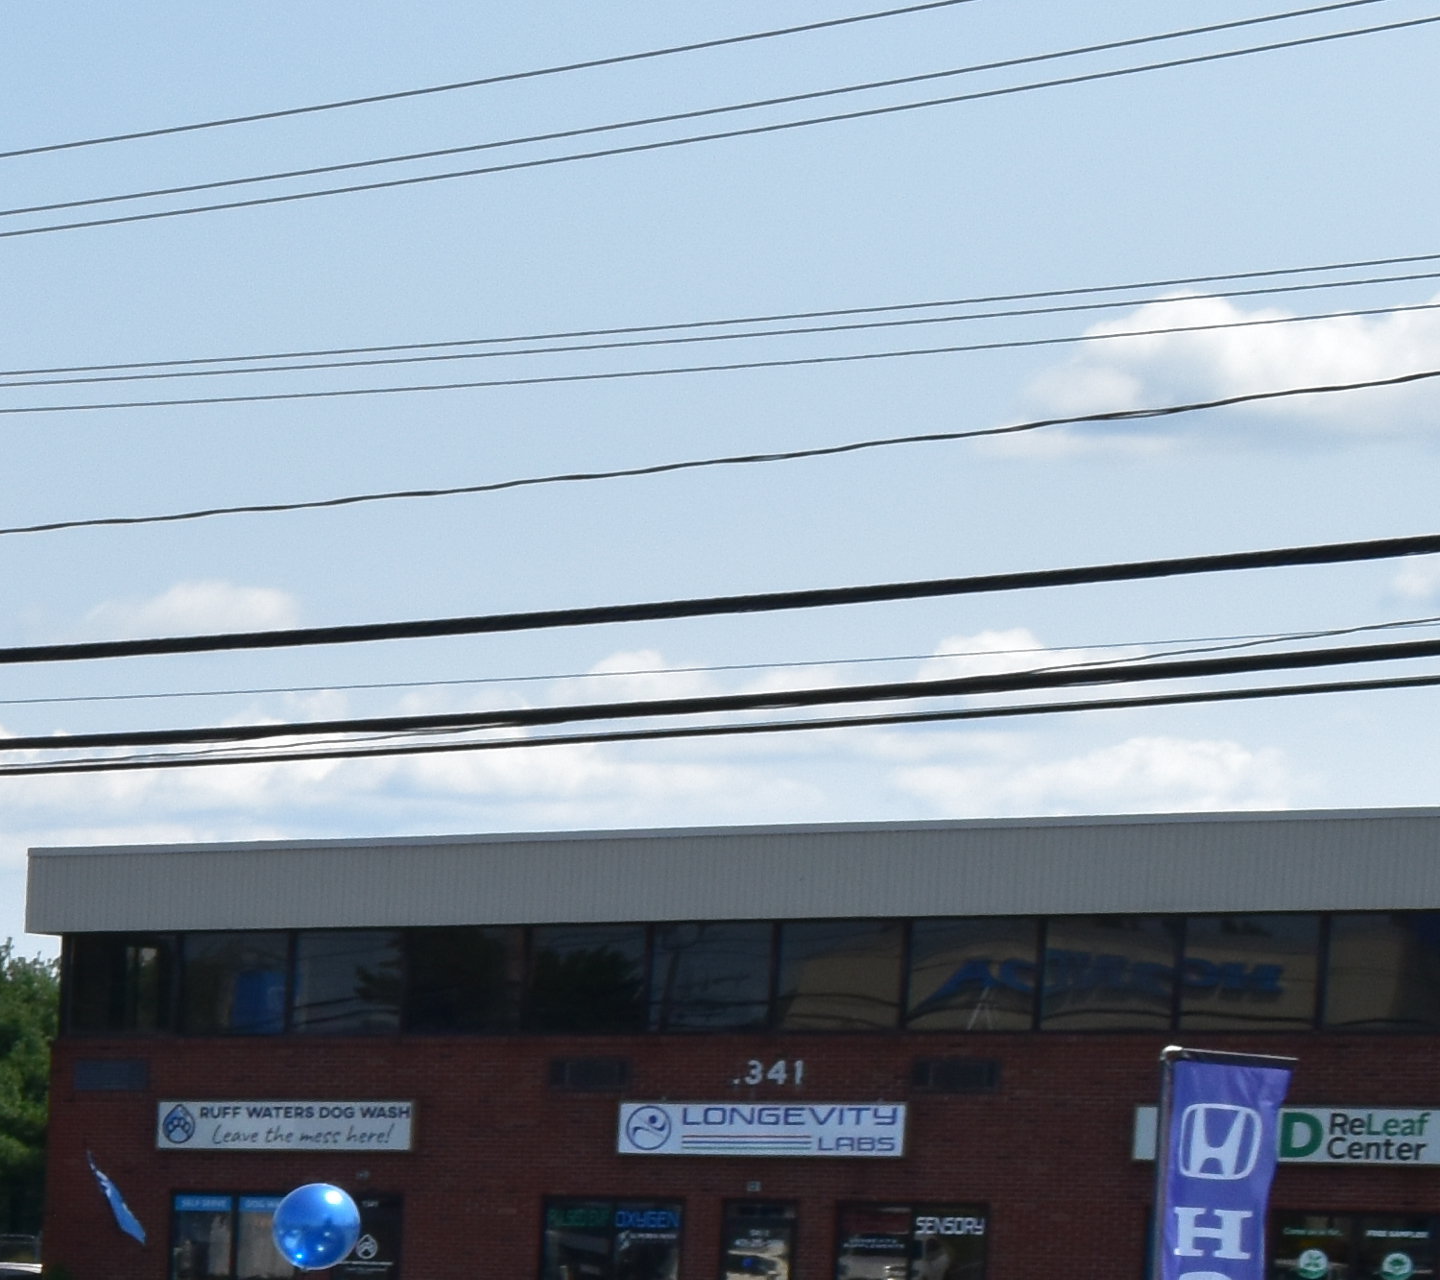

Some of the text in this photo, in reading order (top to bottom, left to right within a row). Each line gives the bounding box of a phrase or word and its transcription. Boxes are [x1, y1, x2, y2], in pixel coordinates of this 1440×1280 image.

[744, 1060, 805, 1085] 341
[199, 1106, 411, 1119] RUFF WATERS DOG WASH
[682, 1107, 898, 1126] LONGEVITY
[211, 1123, 394, 1144] Leave the mess here!
[1329, 1112, 1432, 1136] ReLeaf
[818, 1136, 895, 1151] LABS
[1327, 1137, 1427, 1161] Center
[615, 1210, 679, 1228] OXYGEN
[916, 1216, 984, 1235] SENSORY
